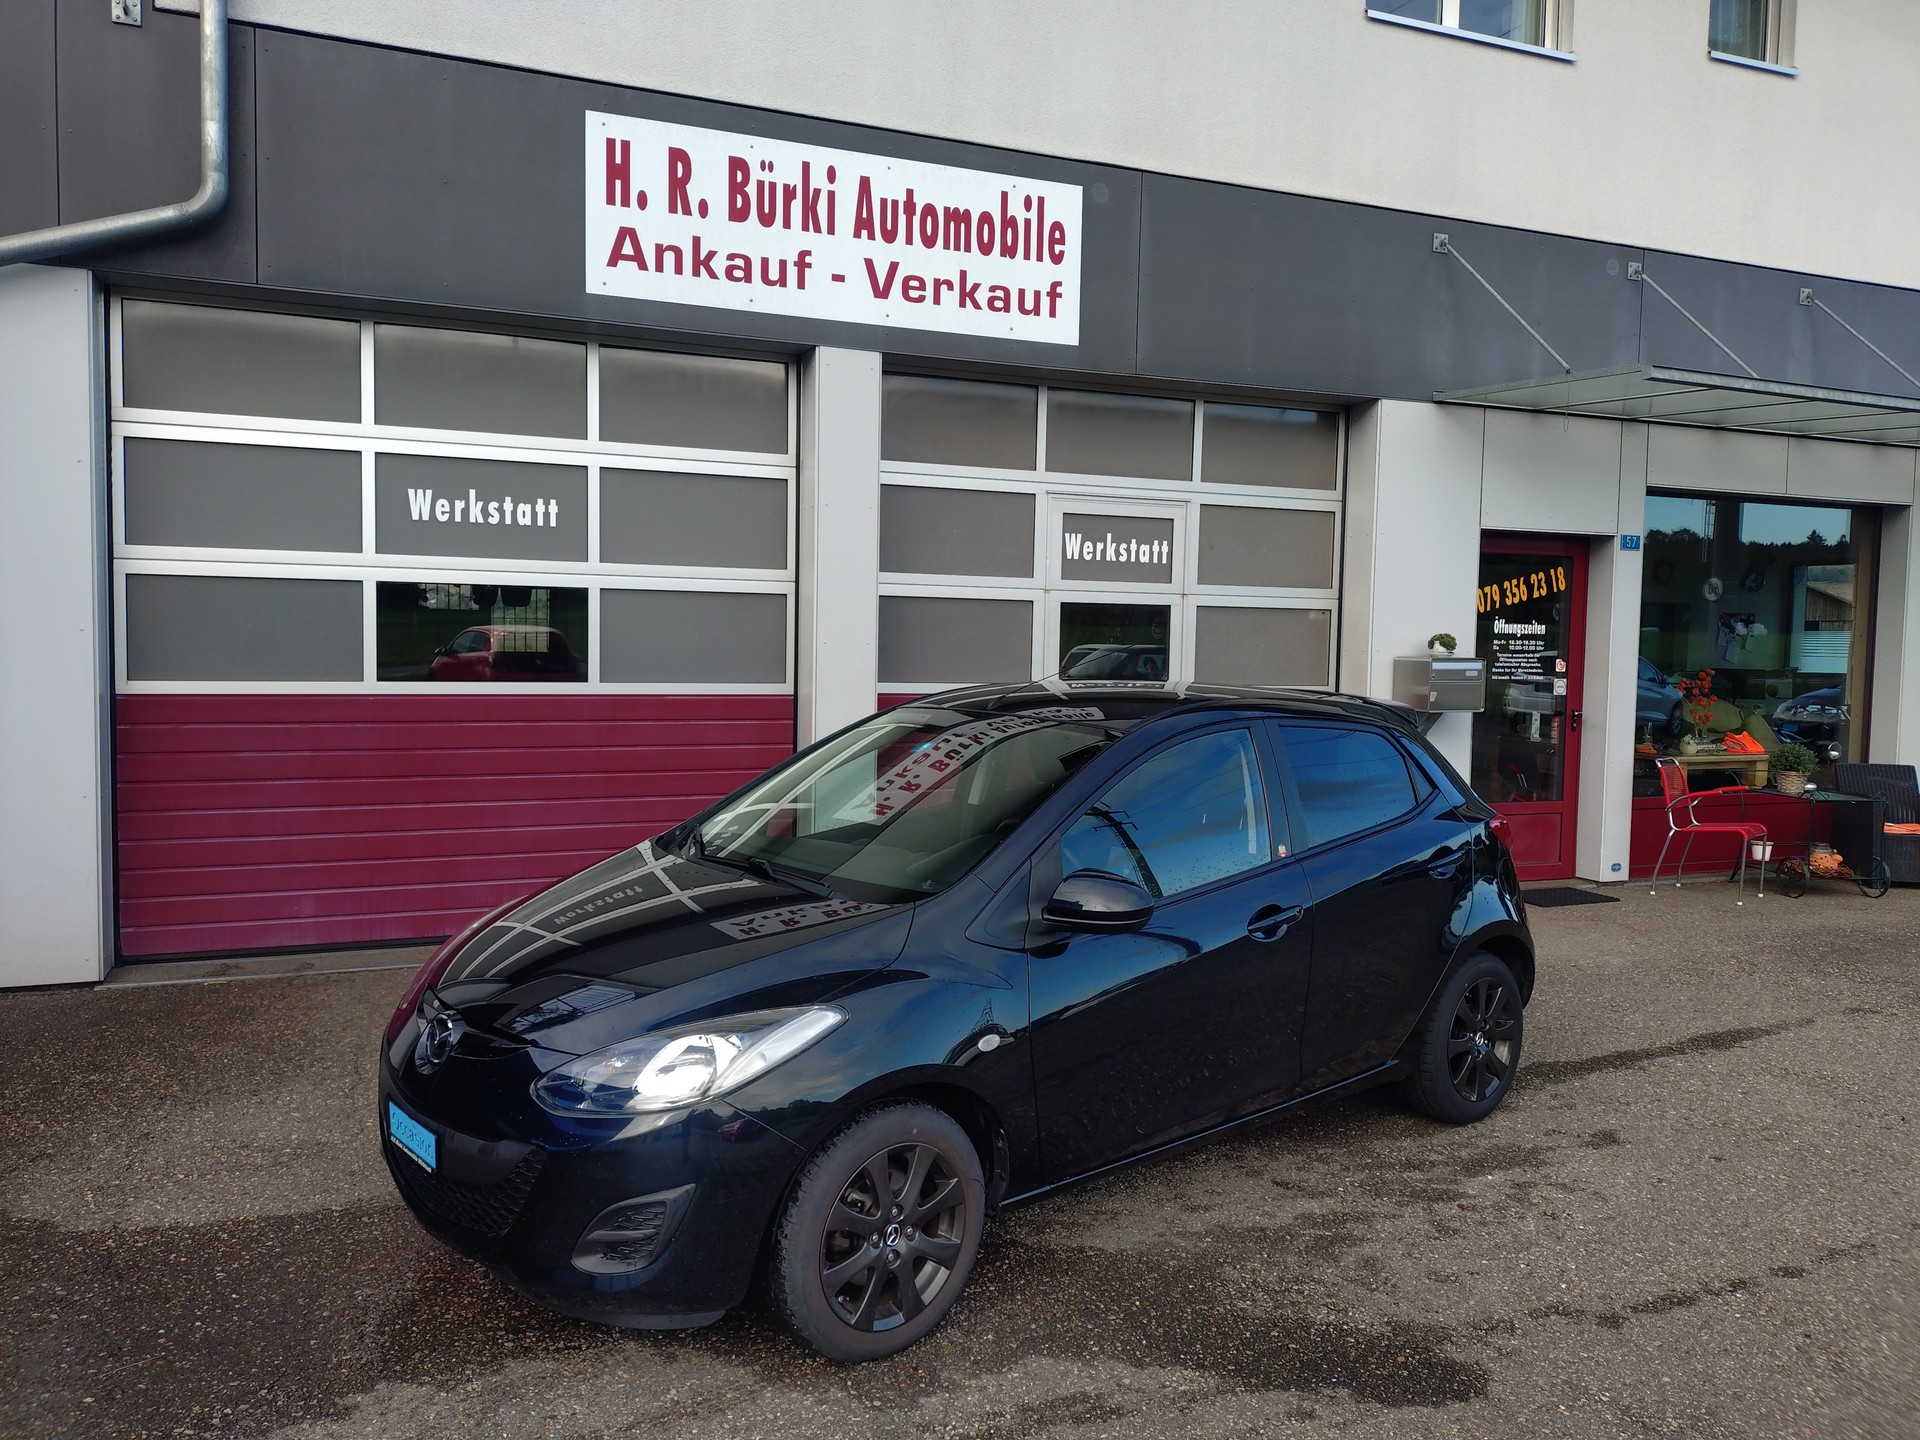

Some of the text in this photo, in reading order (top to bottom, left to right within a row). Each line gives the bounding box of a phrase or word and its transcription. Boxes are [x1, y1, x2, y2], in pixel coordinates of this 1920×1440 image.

[605, 137, 1066, 265] H. R. Bürki Automobile
[606, 226, 812, 290] Ankauf
[863, 257, 1062, 319] Verkauf
[407, 488, 558, 527] Werkstatt
[1064, 532, 1169, 564] Werkstatt
[1626, 537, 1637, 548] 57
[1477, 566, 1566, 614] 079 356 23 18
[1493, 615, 1546, 637] Öffnungszeiten
